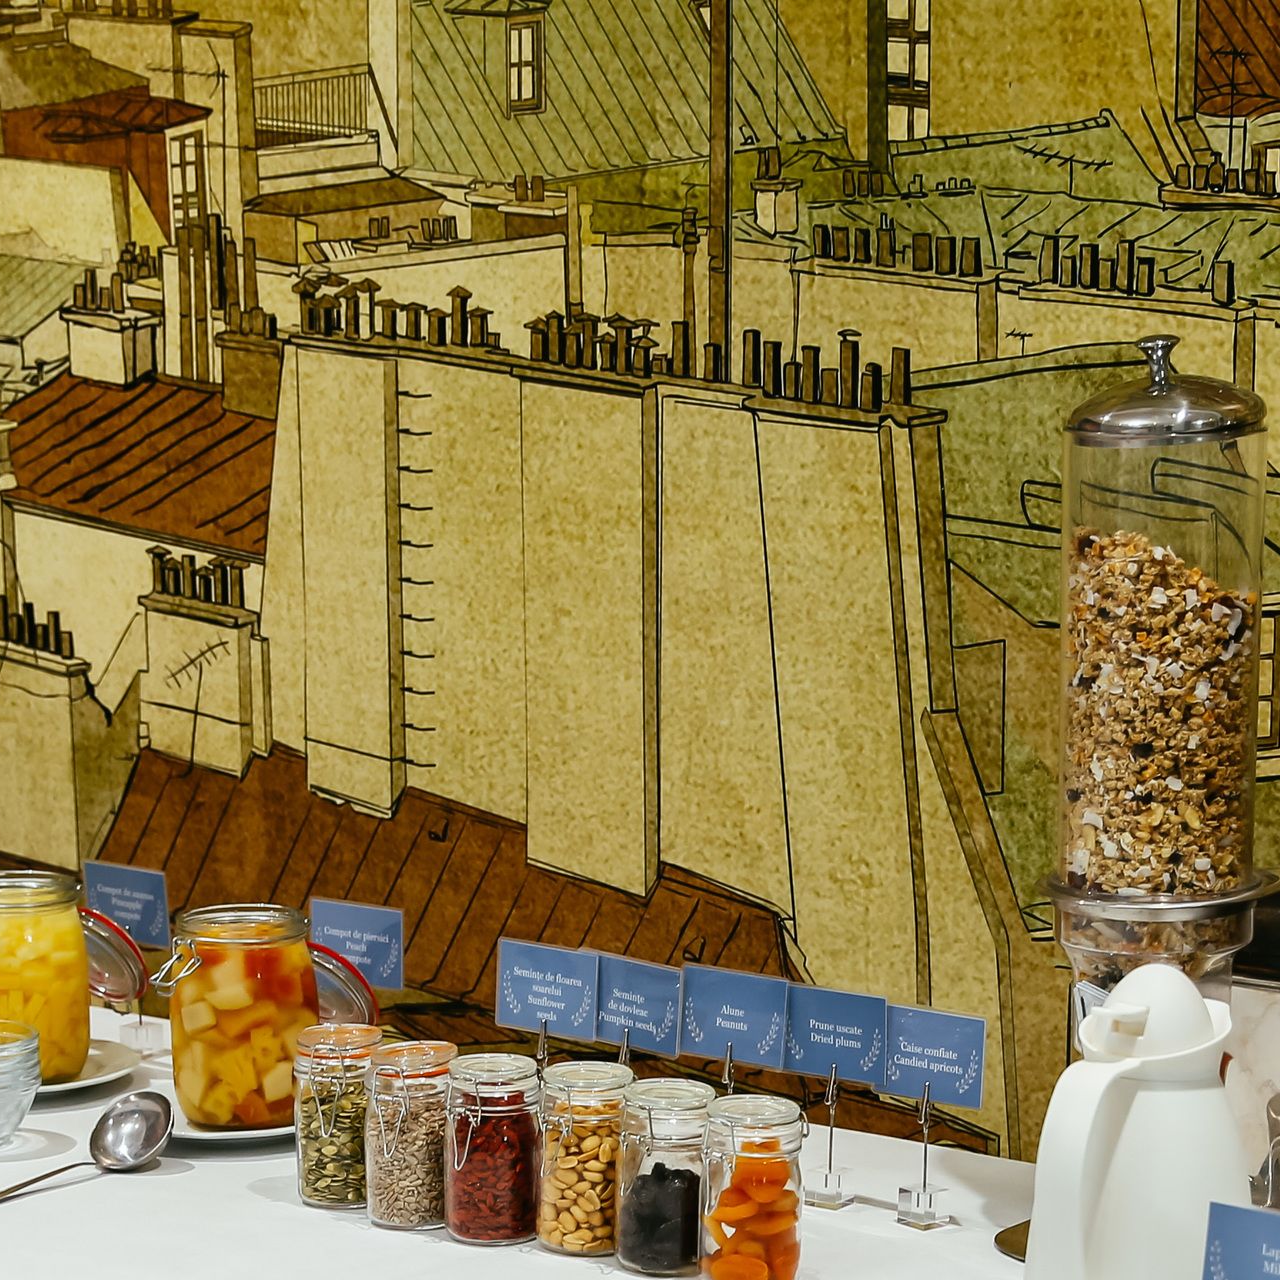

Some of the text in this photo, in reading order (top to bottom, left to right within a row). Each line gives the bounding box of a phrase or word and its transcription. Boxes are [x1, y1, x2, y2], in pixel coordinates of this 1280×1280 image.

[324, 926, 389, 943] Compot de piersici
[346, 941, 367, 952] Peach
[545, 972, 555, 981] de
[556, 973, 582, 987] floarea
[532, 985, 562, 996] soarelui
[527, 994, 566, 1010] Sunflower
[607, 999, 649, 1018] de dovleac
[536, 1010, 557, 1021] seeds
[720, 1004, 745, 1017] Alune
[599, 1010, 657, 1036] Pumpkin seeds
[716, 1017, 748, 1032] Peanuts
[809, 1018, 863, 1036] Prune uscate
[810, 1032, 862, 1049] Dried plums
[900, 1042, 958, 1060] Caise confiate
[894, 1054, 963, 1075] Candied apricots
